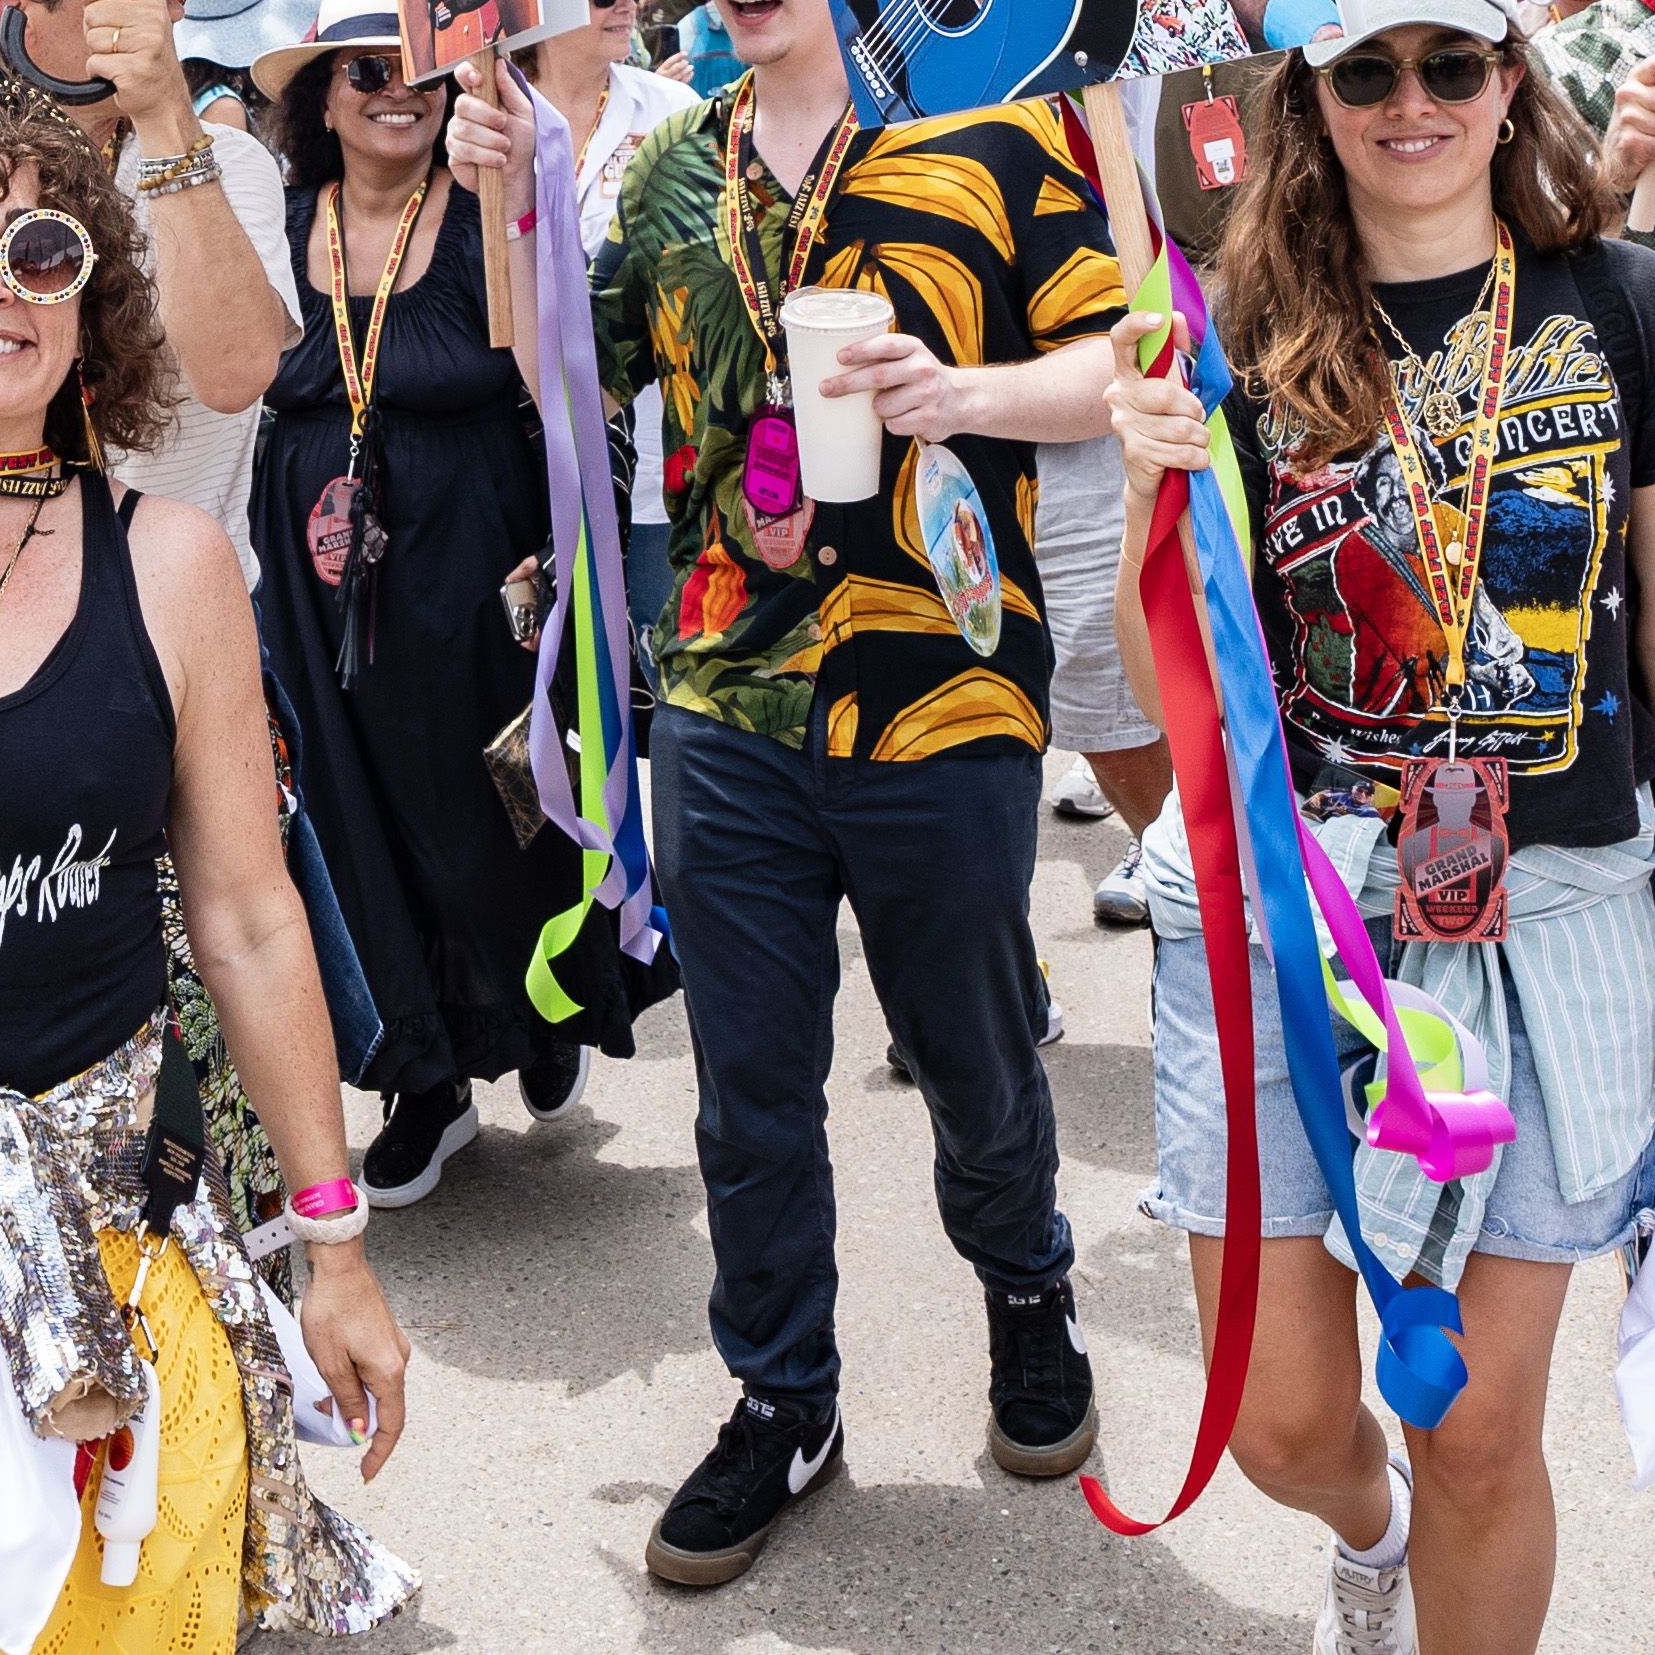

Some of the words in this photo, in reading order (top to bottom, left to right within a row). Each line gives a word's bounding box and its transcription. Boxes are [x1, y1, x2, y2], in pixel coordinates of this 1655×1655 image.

[1454, 398, 1619, 469] CNCERT
[1416, 852, 1490, 893] MARSHAL
[1425, 844, 1478, 877] GRAND
[1437, 890, 1468, 902] VIP
